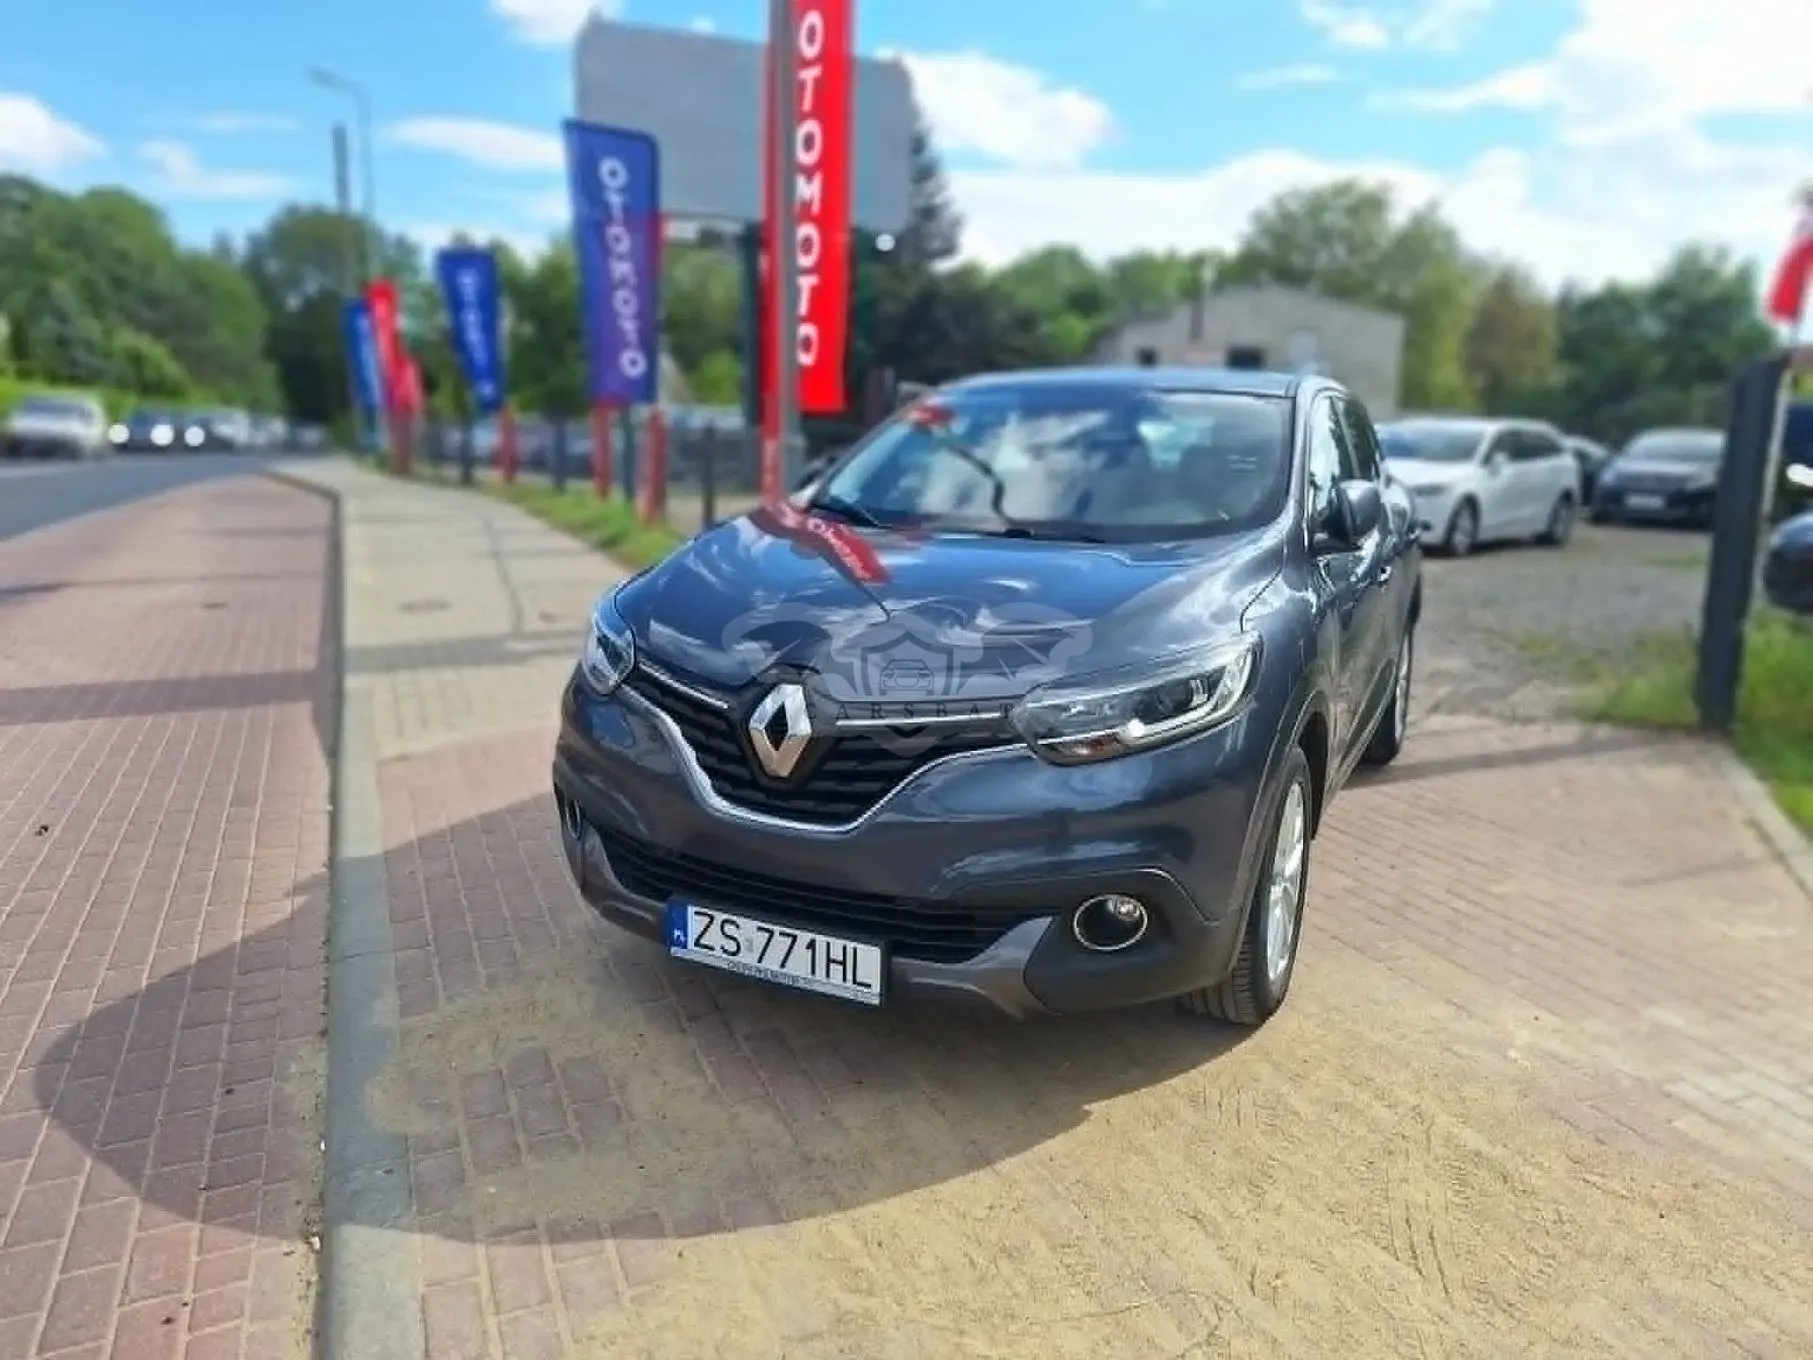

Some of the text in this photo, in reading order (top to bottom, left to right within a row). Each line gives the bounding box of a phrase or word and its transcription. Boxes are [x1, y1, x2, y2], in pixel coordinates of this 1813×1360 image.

[795, 9, 824, 367] OTOMOTO
[693, 910, 742, 957] ZS
[757, 925, 872, 989] 771HL
